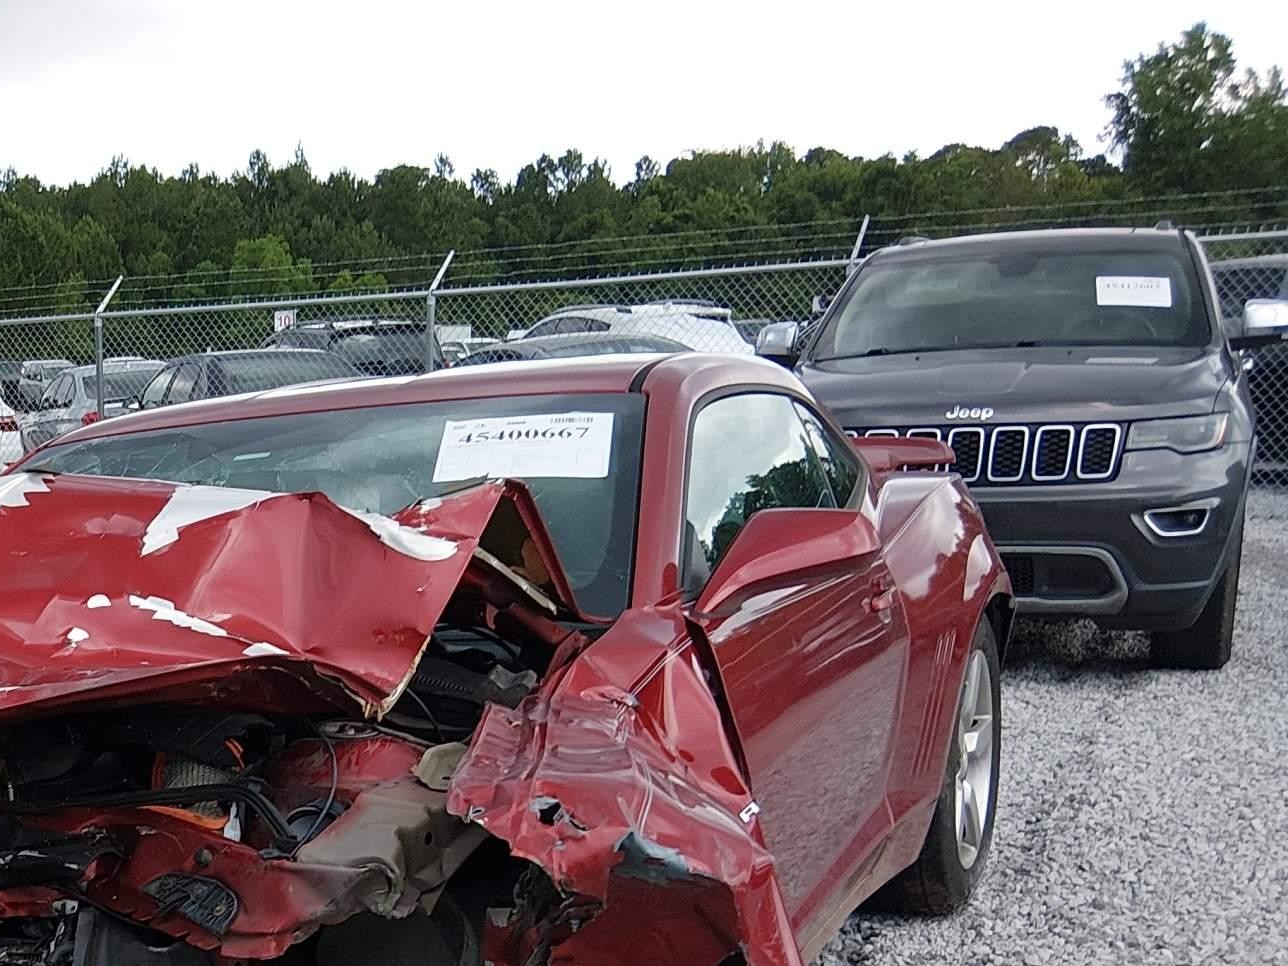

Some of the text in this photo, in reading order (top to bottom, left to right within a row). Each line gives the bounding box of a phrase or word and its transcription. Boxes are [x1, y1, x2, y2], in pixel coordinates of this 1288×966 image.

[277, 315, 291, 328] 10
[945, 404, 994, 421] Jeep
[458, 426, 590, 444] 45400667
